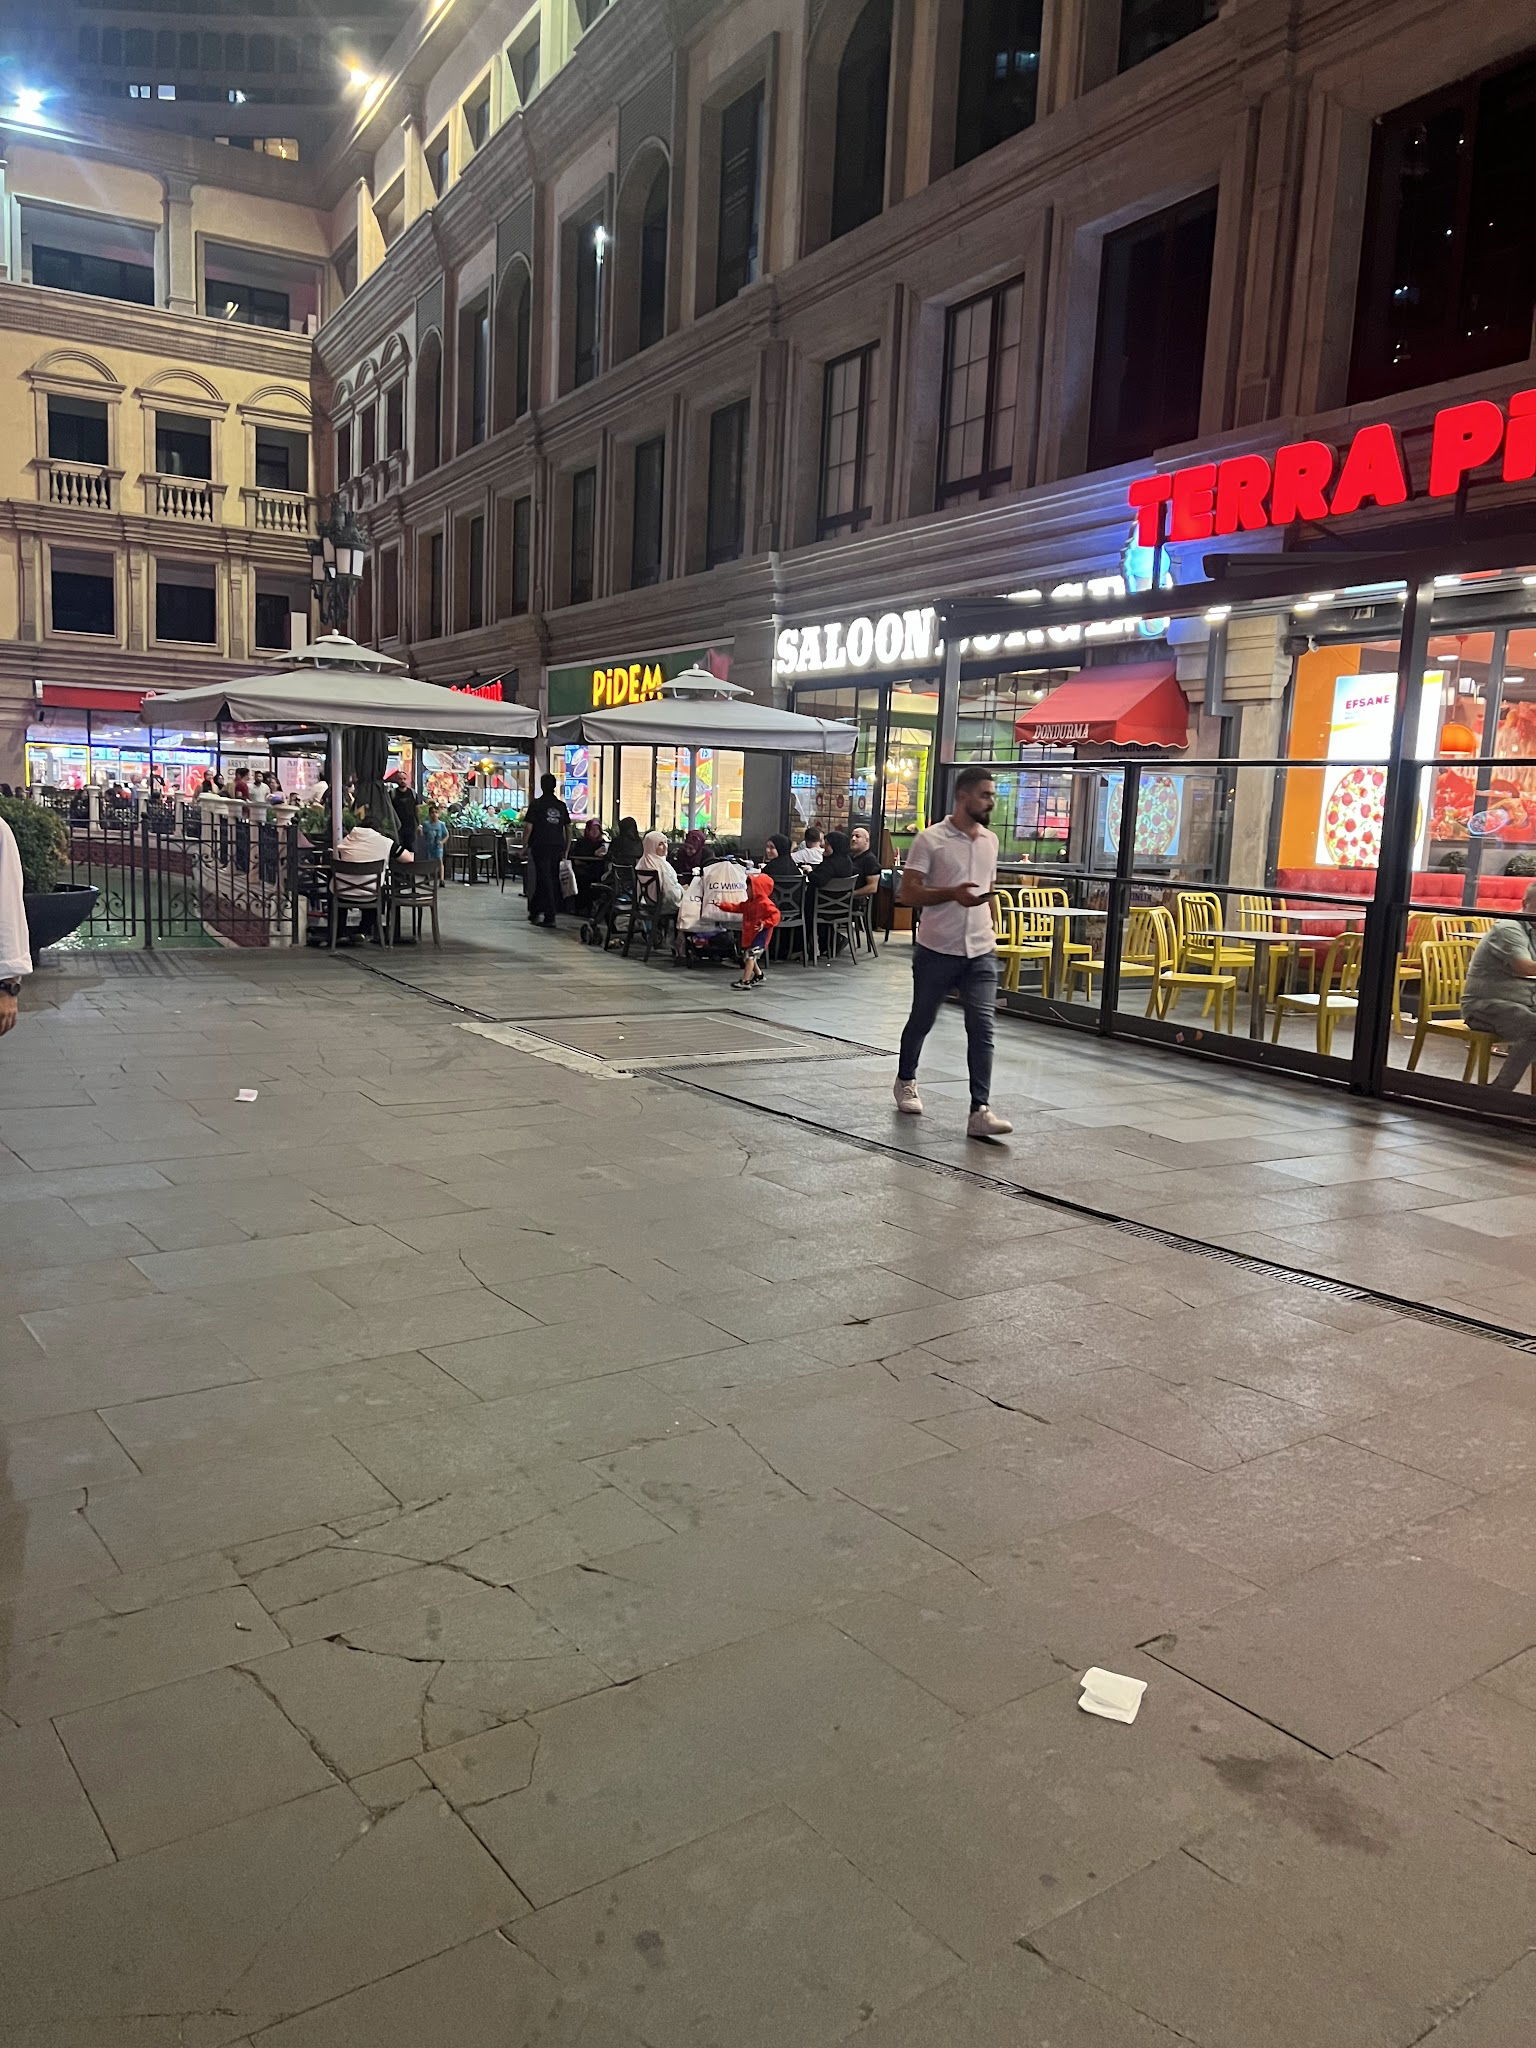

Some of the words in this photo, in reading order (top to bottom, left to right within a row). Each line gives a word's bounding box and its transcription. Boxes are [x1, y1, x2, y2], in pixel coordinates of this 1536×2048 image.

[1128, 422, 1407, 548] TERRA
[776, 607, 938, 674] SALOON
[1345, 694, 1391, 710] EFSANE
[1032, 723, 1090, 739] DONDURMA
